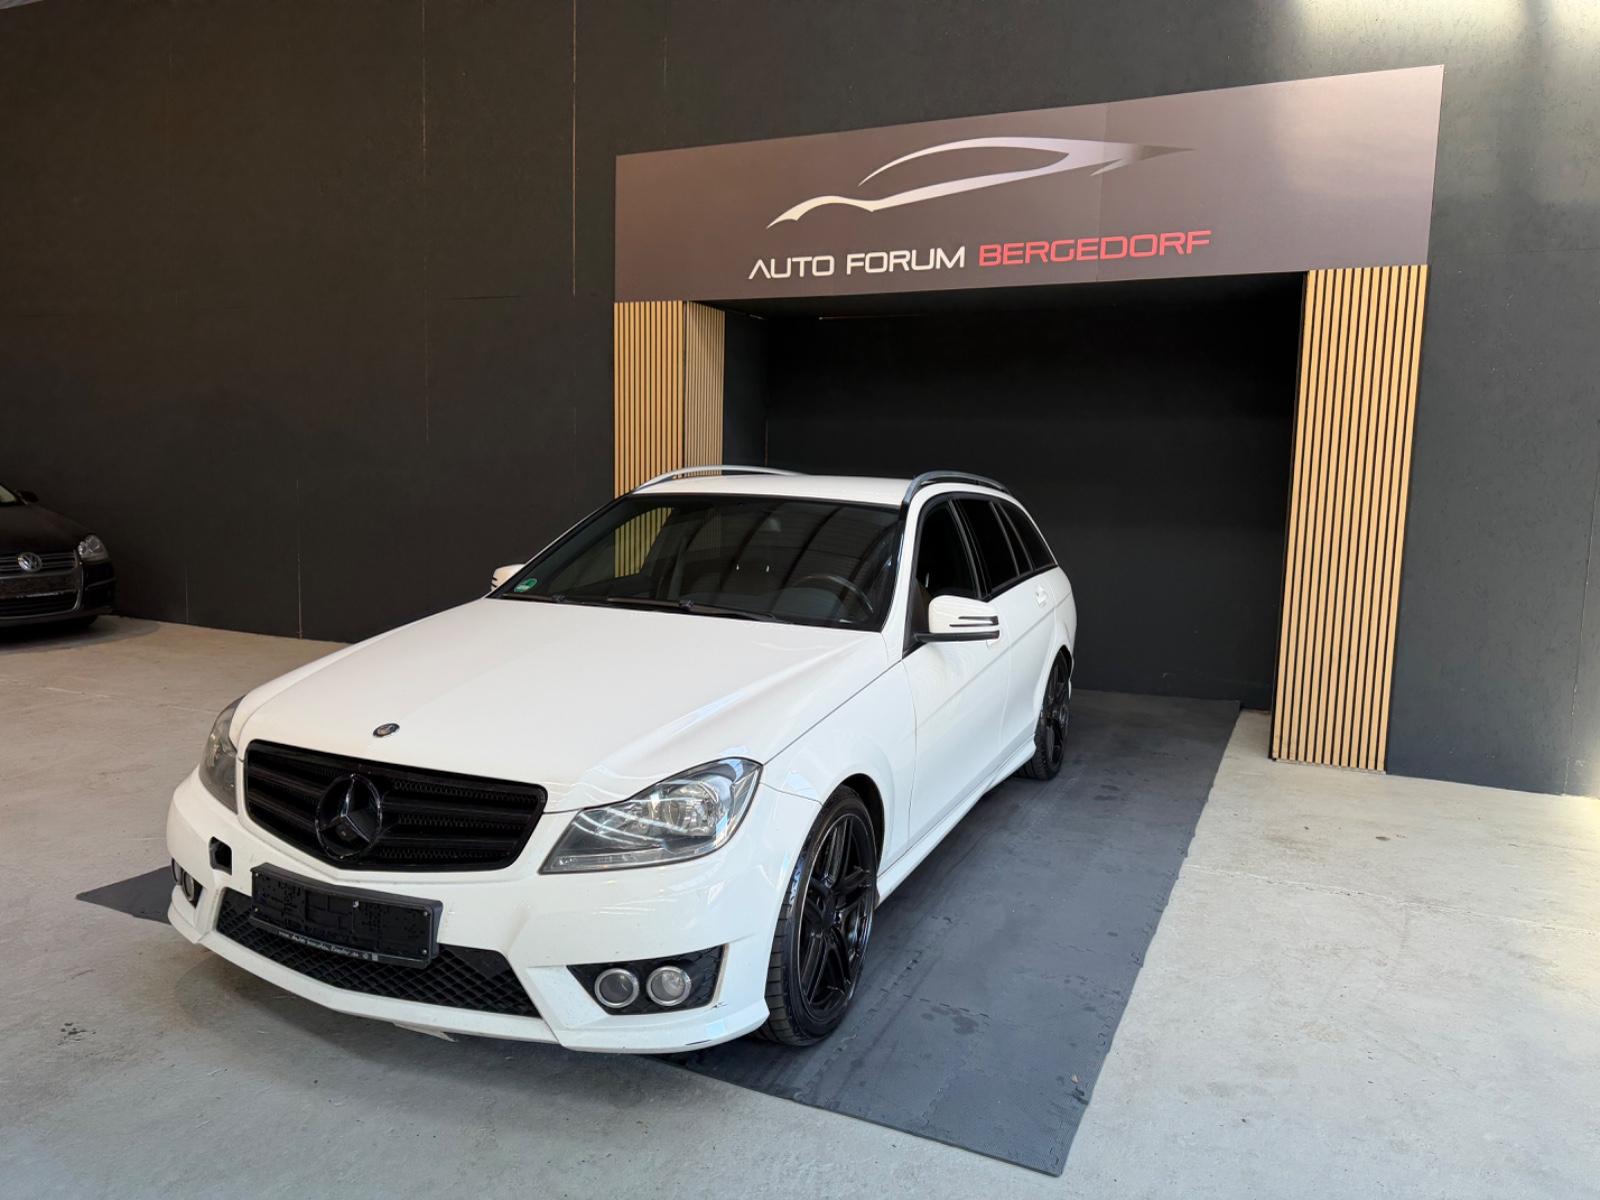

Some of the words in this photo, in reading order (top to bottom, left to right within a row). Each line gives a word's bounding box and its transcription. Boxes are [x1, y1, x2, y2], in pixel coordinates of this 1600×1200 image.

[749, 255, 834, 280] AUTO
[847, 246, 965, 275] FORUM
[979, 230, 1212, 267] BERGEDORF
